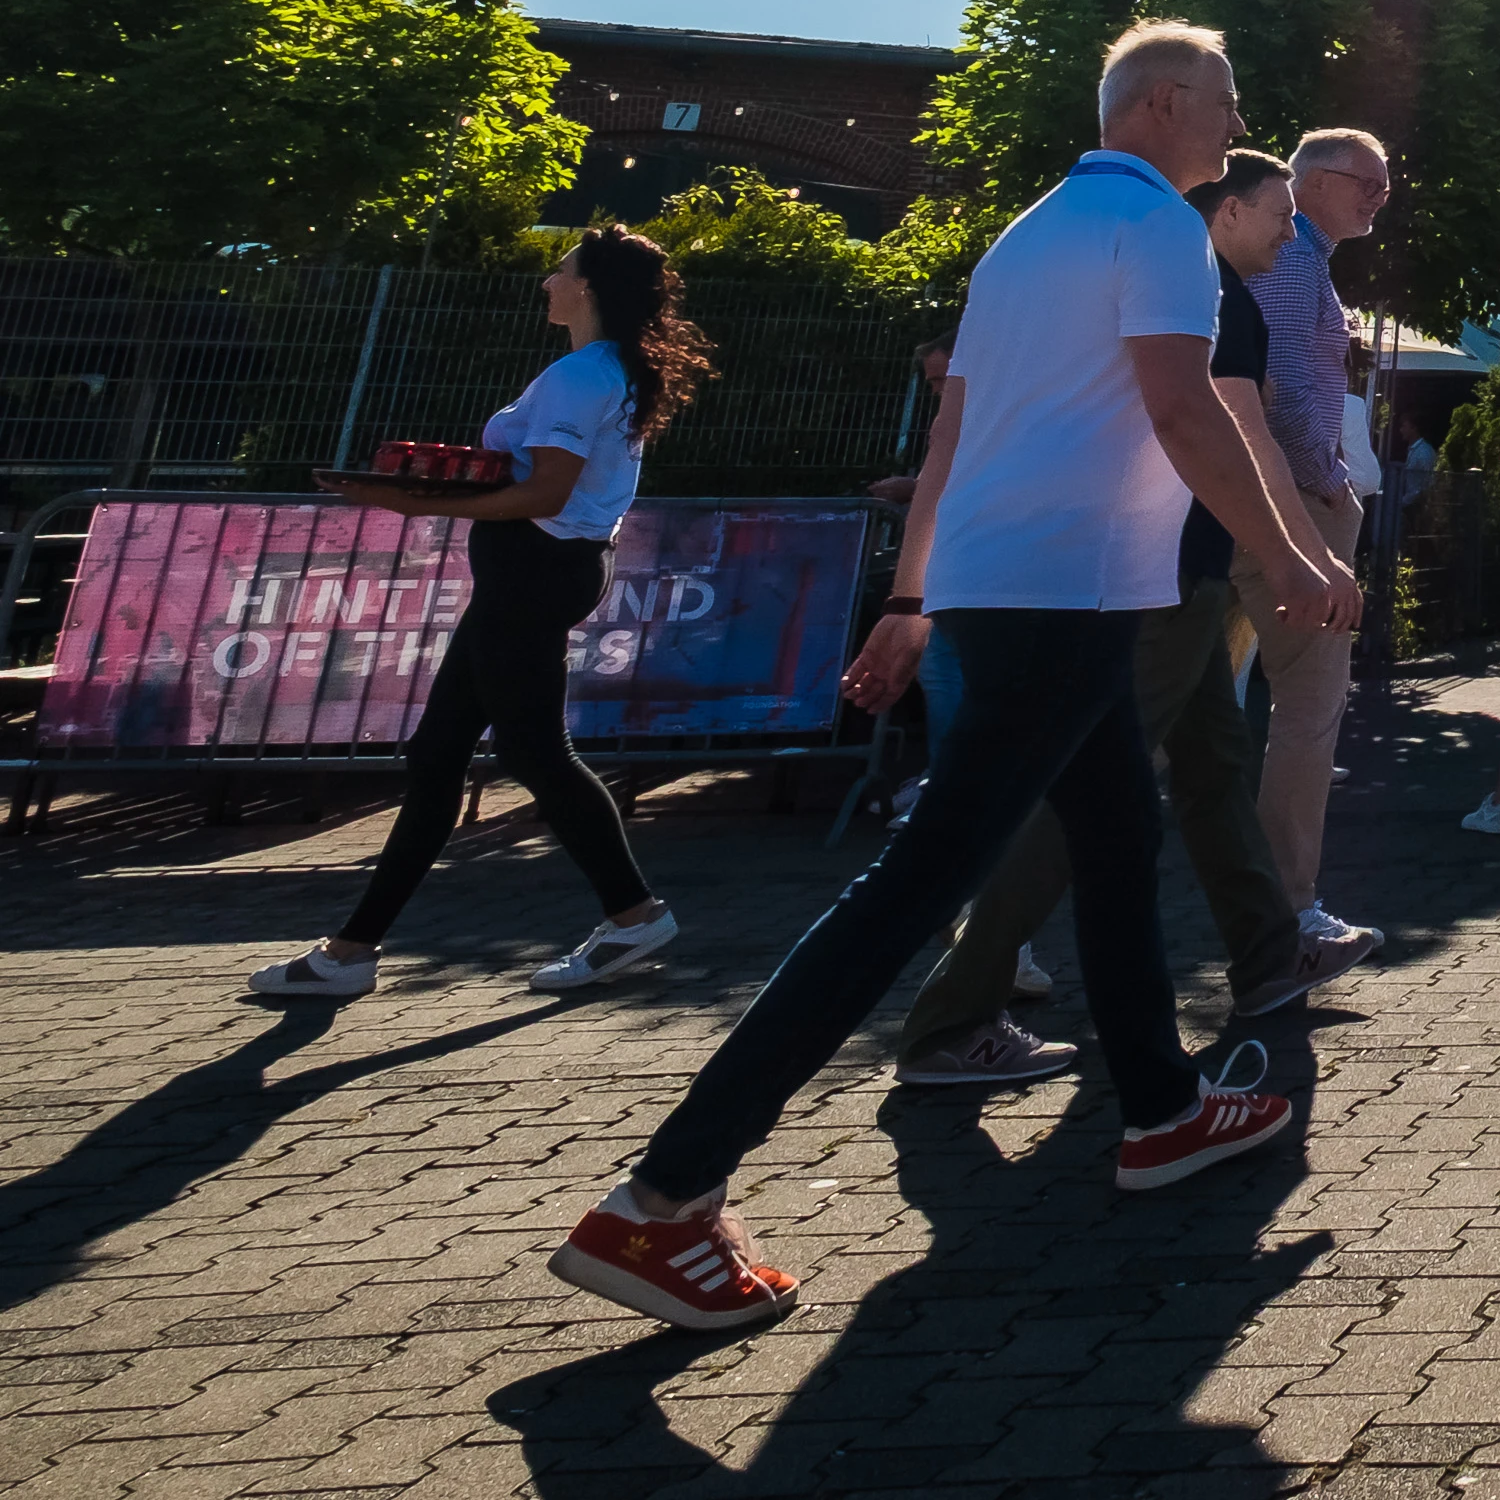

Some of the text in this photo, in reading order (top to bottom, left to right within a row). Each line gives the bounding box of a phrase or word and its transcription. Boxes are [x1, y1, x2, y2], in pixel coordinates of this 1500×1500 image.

[675, 104, 691, 128] 7
[226, 575, 715, 623] HINTEND
[213, 631, 323, 678] OF
[1296, 949, 1323, 976] N
[966, 1037, 1010, 1067] N
